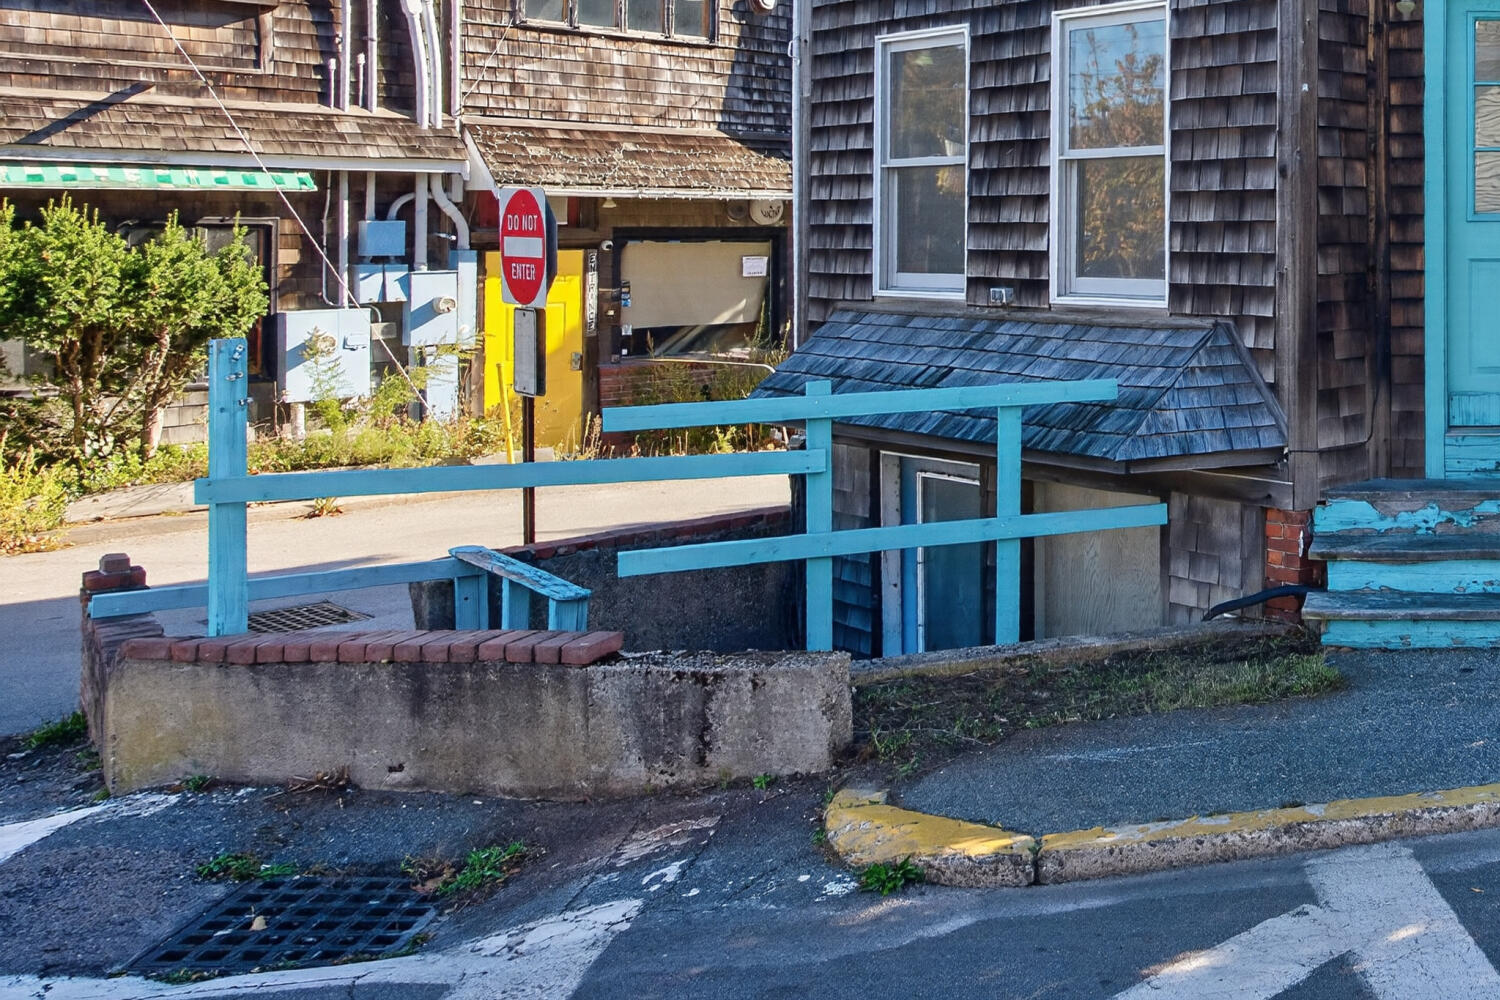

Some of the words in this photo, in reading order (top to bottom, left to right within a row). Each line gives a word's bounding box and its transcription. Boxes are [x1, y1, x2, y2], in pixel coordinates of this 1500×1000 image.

[507, 214, 520, 231] DO
[522, 214, 538, 231] NOT
[511, 262, 536, 280] ENTER
